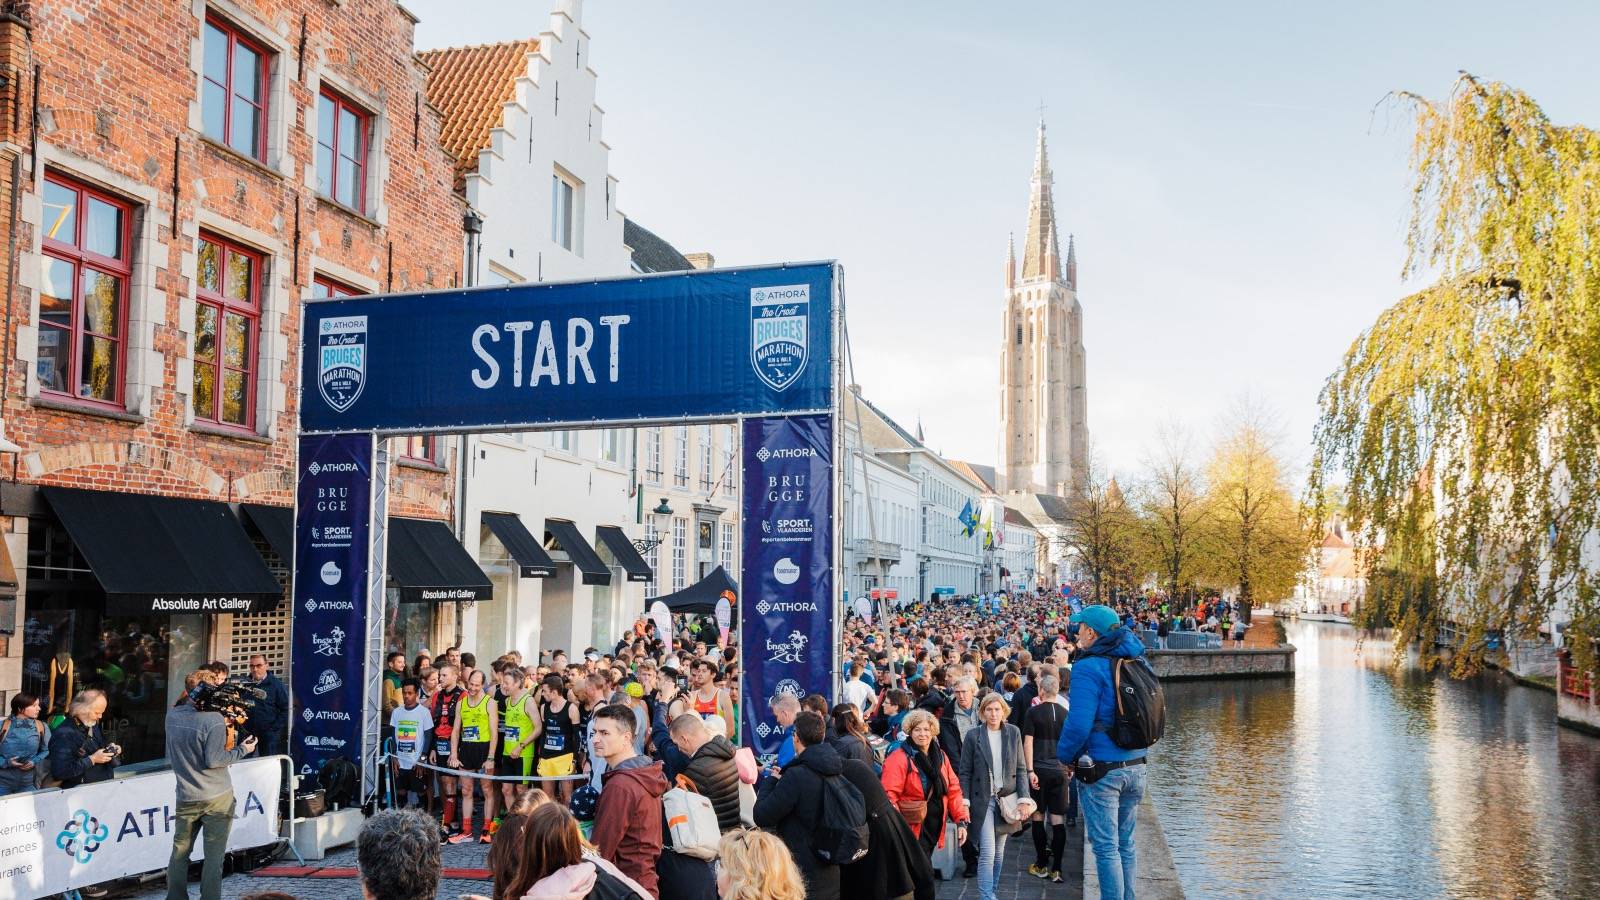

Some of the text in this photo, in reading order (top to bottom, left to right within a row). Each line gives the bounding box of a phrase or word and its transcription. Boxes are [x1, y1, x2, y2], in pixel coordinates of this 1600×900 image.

[767, 290, 807, 300] ATHORA
[333, 320, 365, 329] ATHORA
[756, 320, 803, 344] BRUGES
[470, 314, 631, 389] START
[757, 343, 803, 362] MARATHON
[323, 347, 361, 369] BRUGES
[323, 368, 361, 385] MARATHON
[772, 448, 818, 458] ATHORA
[321, 463, 358, 472] ATHORA
[769, 475, 805, 487] BRU
[318, 487, 348, 497] BRU
[768, 490, 804, 502] GGE
[317, 501, 347, 511] GGE
[422, 589, 476, 599] Absolute Art Gallery
[152, 597, 251, 611] Absolute Art Gallery
[318, 601, 354, 610] ATHORA
[772, 602, 818, 612] ATHORA
[315, 711, 351, 721] ATHORA
[116, 790, 265, 843] ATHA
